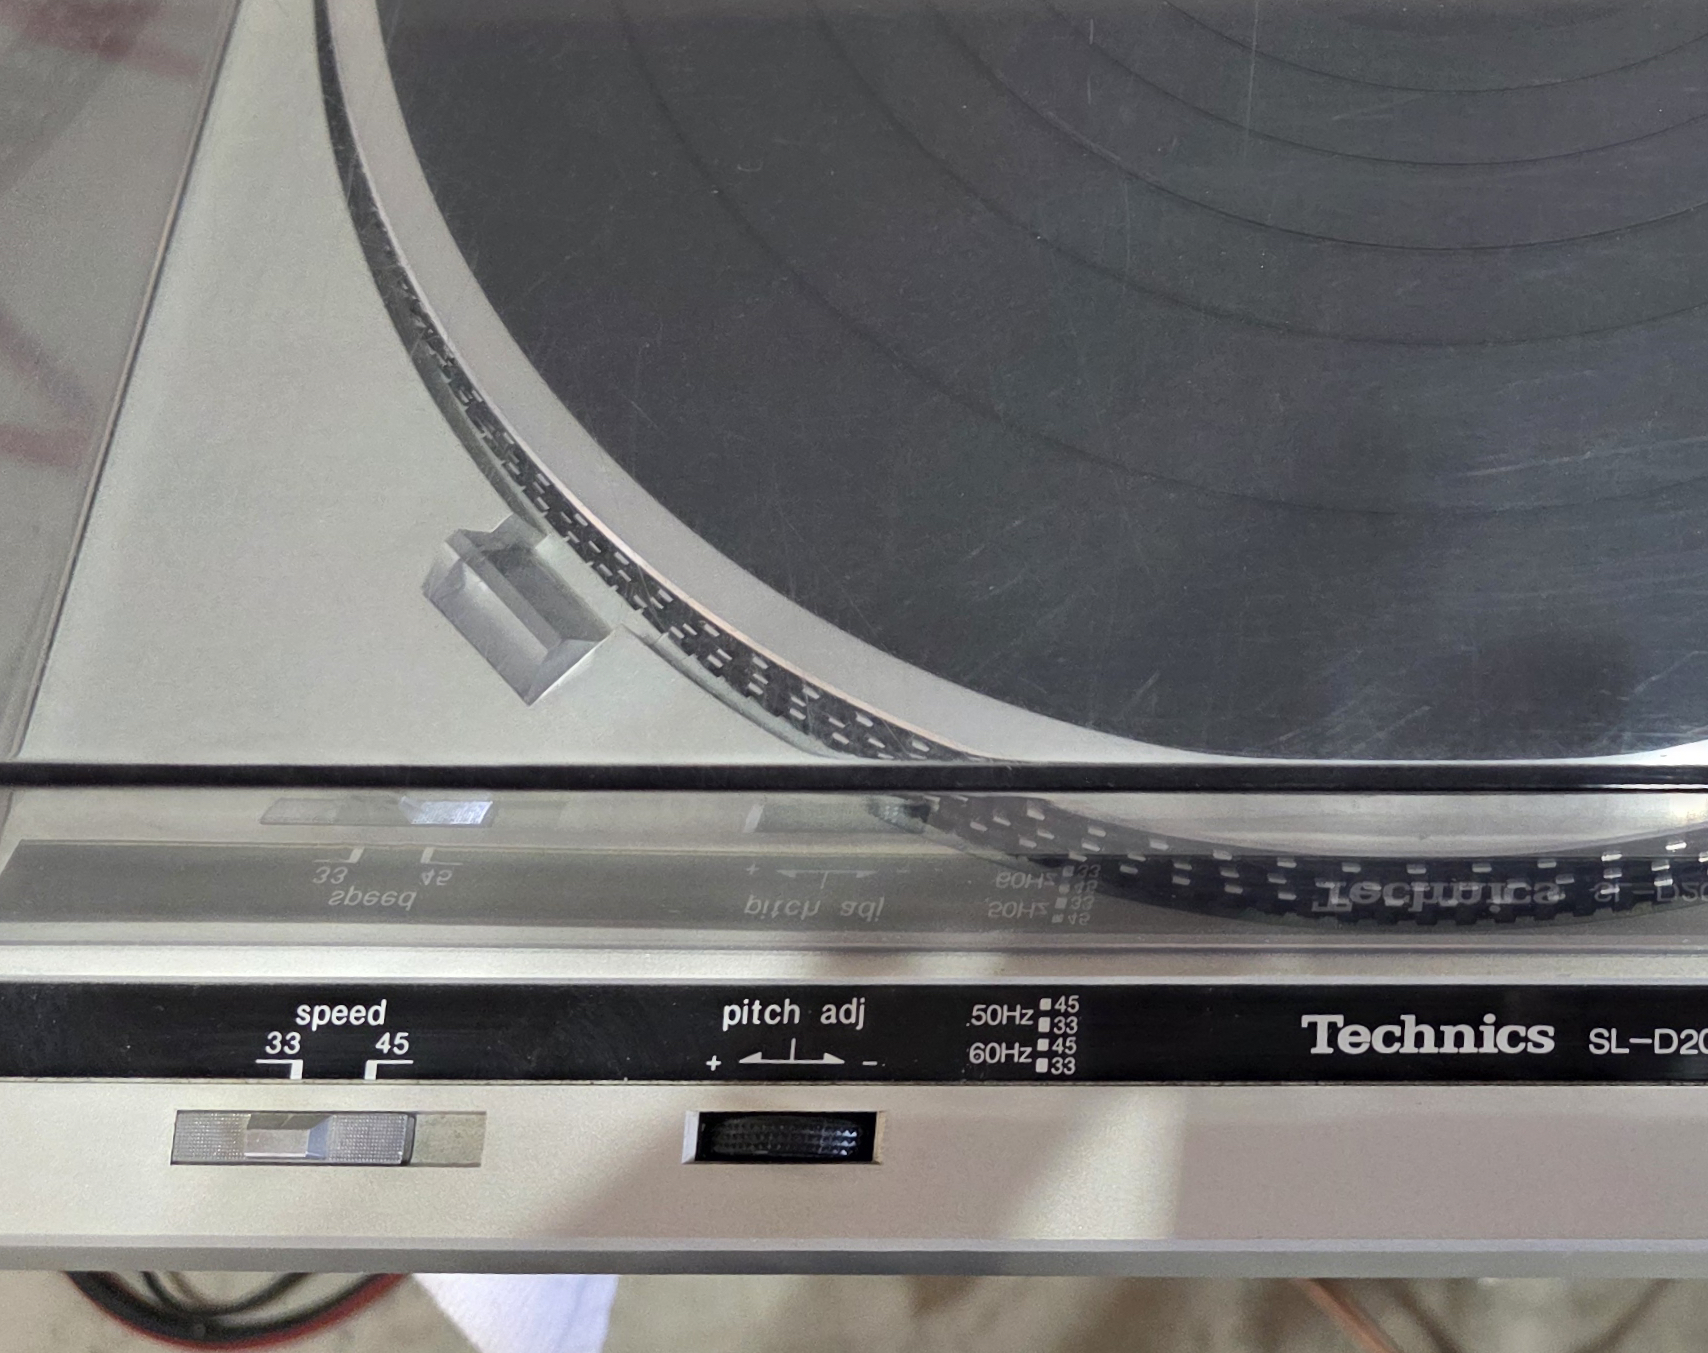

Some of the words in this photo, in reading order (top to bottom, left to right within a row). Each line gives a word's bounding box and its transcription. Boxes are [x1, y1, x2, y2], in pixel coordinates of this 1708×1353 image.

[294, 999, 387, 1029] speed
[722, 998, 801, 1032] pitch
[820, 997, 866, 1031] adj
[970, 1004, 1034, 1026] 50Hz
[1054, 994, 1080, 1014] 45
[1053, 1015, 1078, 1035] 33
[1301, 1013, 1555, 1055] Technics
[265, 1031, 301, 1055] 33
[375, 1031, 410, 1055] 45
[969, 1042, 1033, 1064] 60Hz
[1051, 1036, 1077, 1055] 45
[1050, 1056, 1076, 1075] 33
